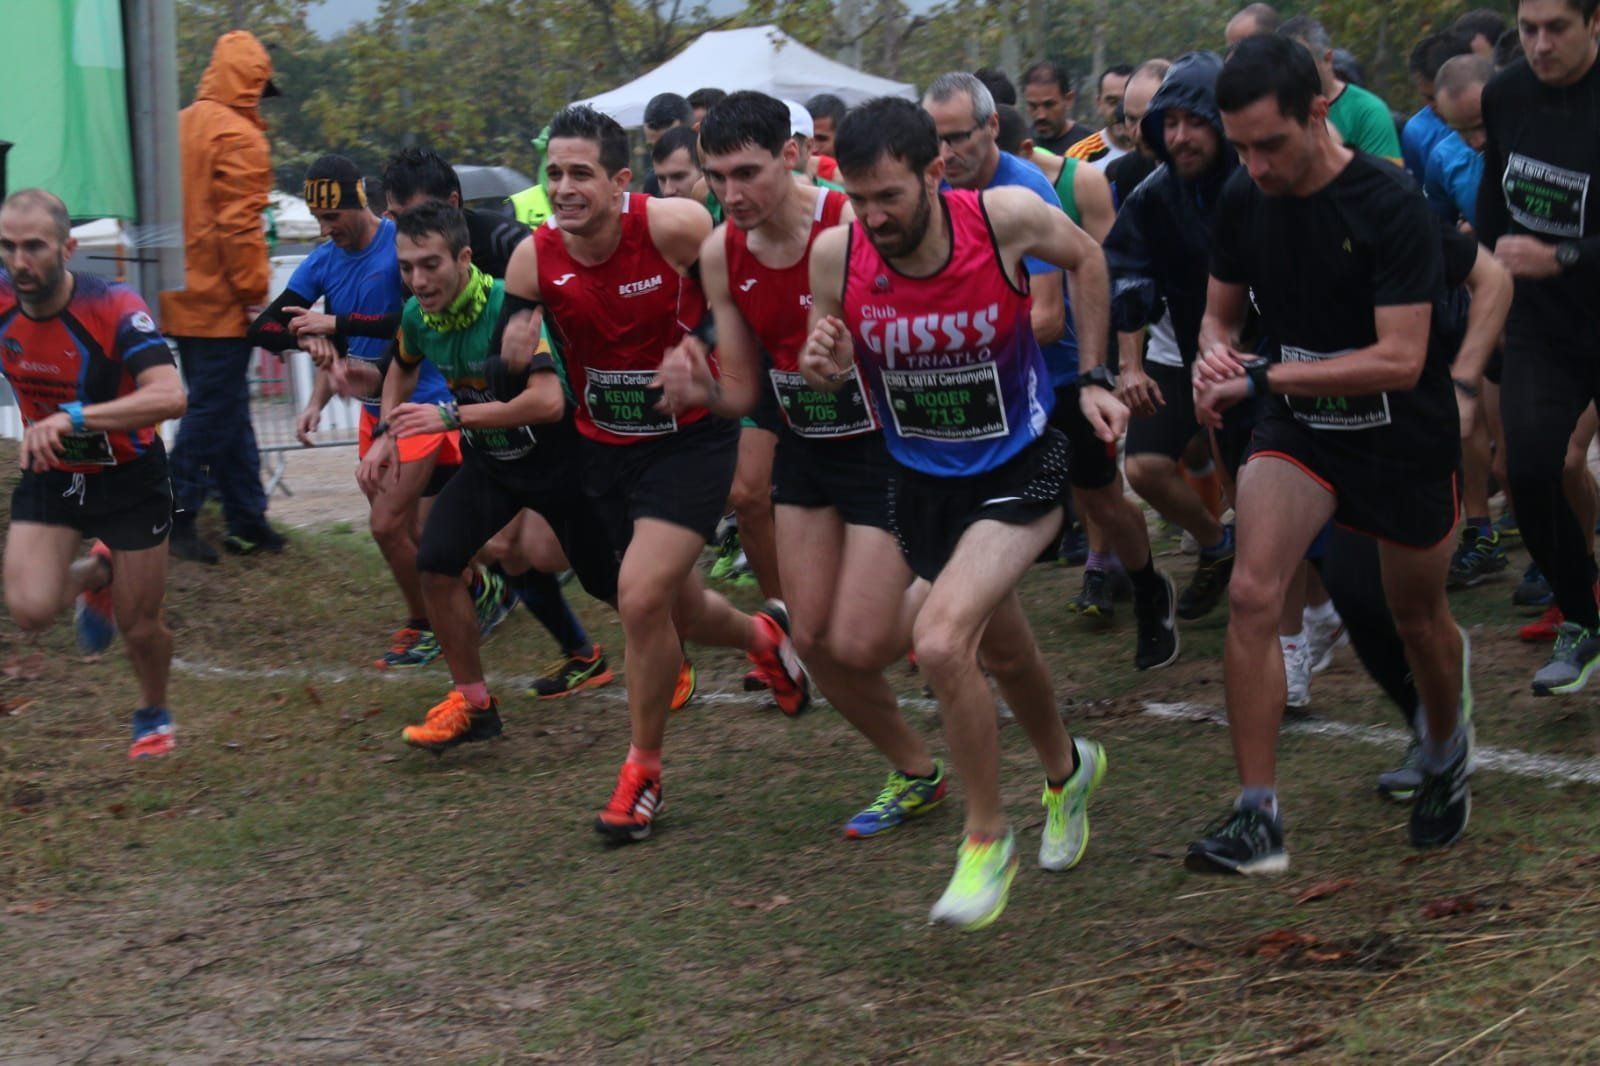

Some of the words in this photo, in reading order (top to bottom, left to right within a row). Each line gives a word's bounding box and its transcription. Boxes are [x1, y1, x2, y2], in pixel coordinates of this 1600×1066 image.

[305, 178, 342, 209] UFF
[861, 304, 897, 319] Club
[603, 390, 646, 404] KEVIN
[913, 390, 971, 408] ROGER
[610, 405, 643, 420] 704
[804, 405, 839, 421] 705
[925, 408, 968, 426] 713
